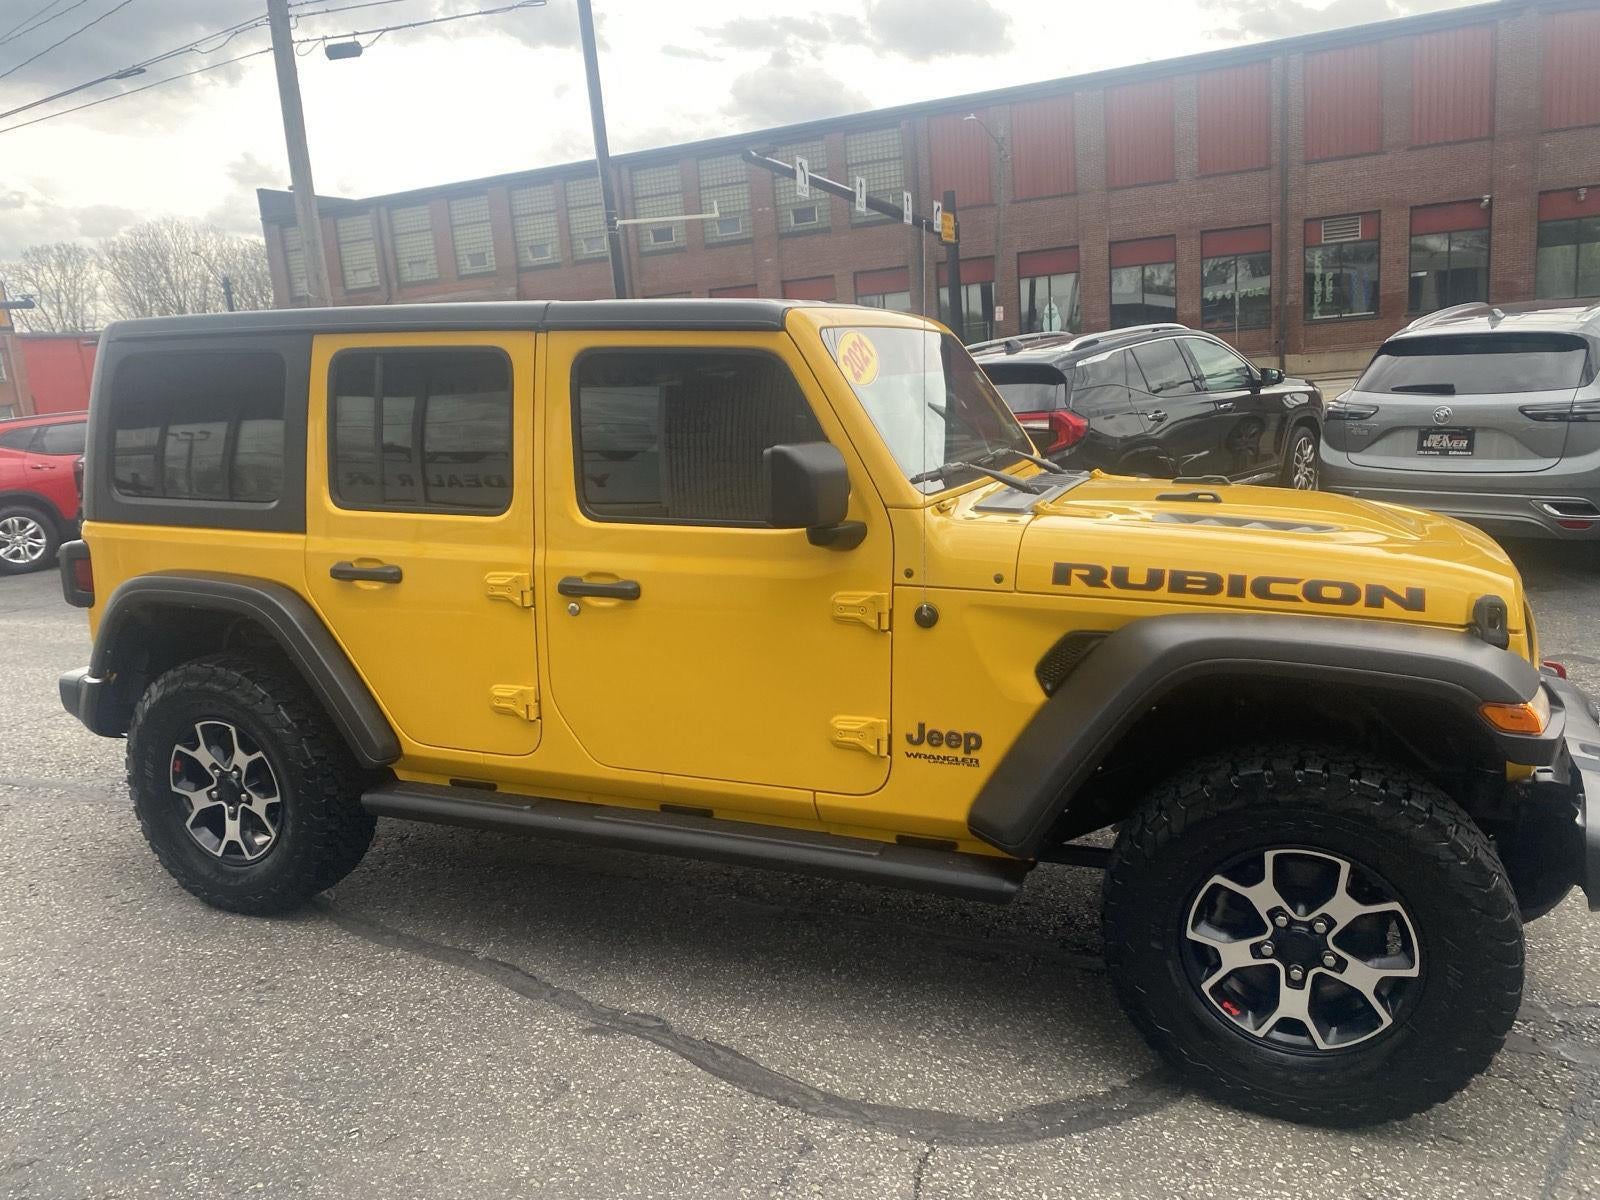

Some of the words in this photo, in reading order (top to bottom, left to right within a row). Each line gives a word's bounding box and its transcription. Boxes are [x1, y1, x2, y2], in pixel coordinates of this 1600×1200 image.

[843, 333, 873, 382] 2021
[1051, 562, 1426, 612] RUBICON
[905, 722, 983, 755] Jeep
[905, 752, 980, 764] WRANGLER
